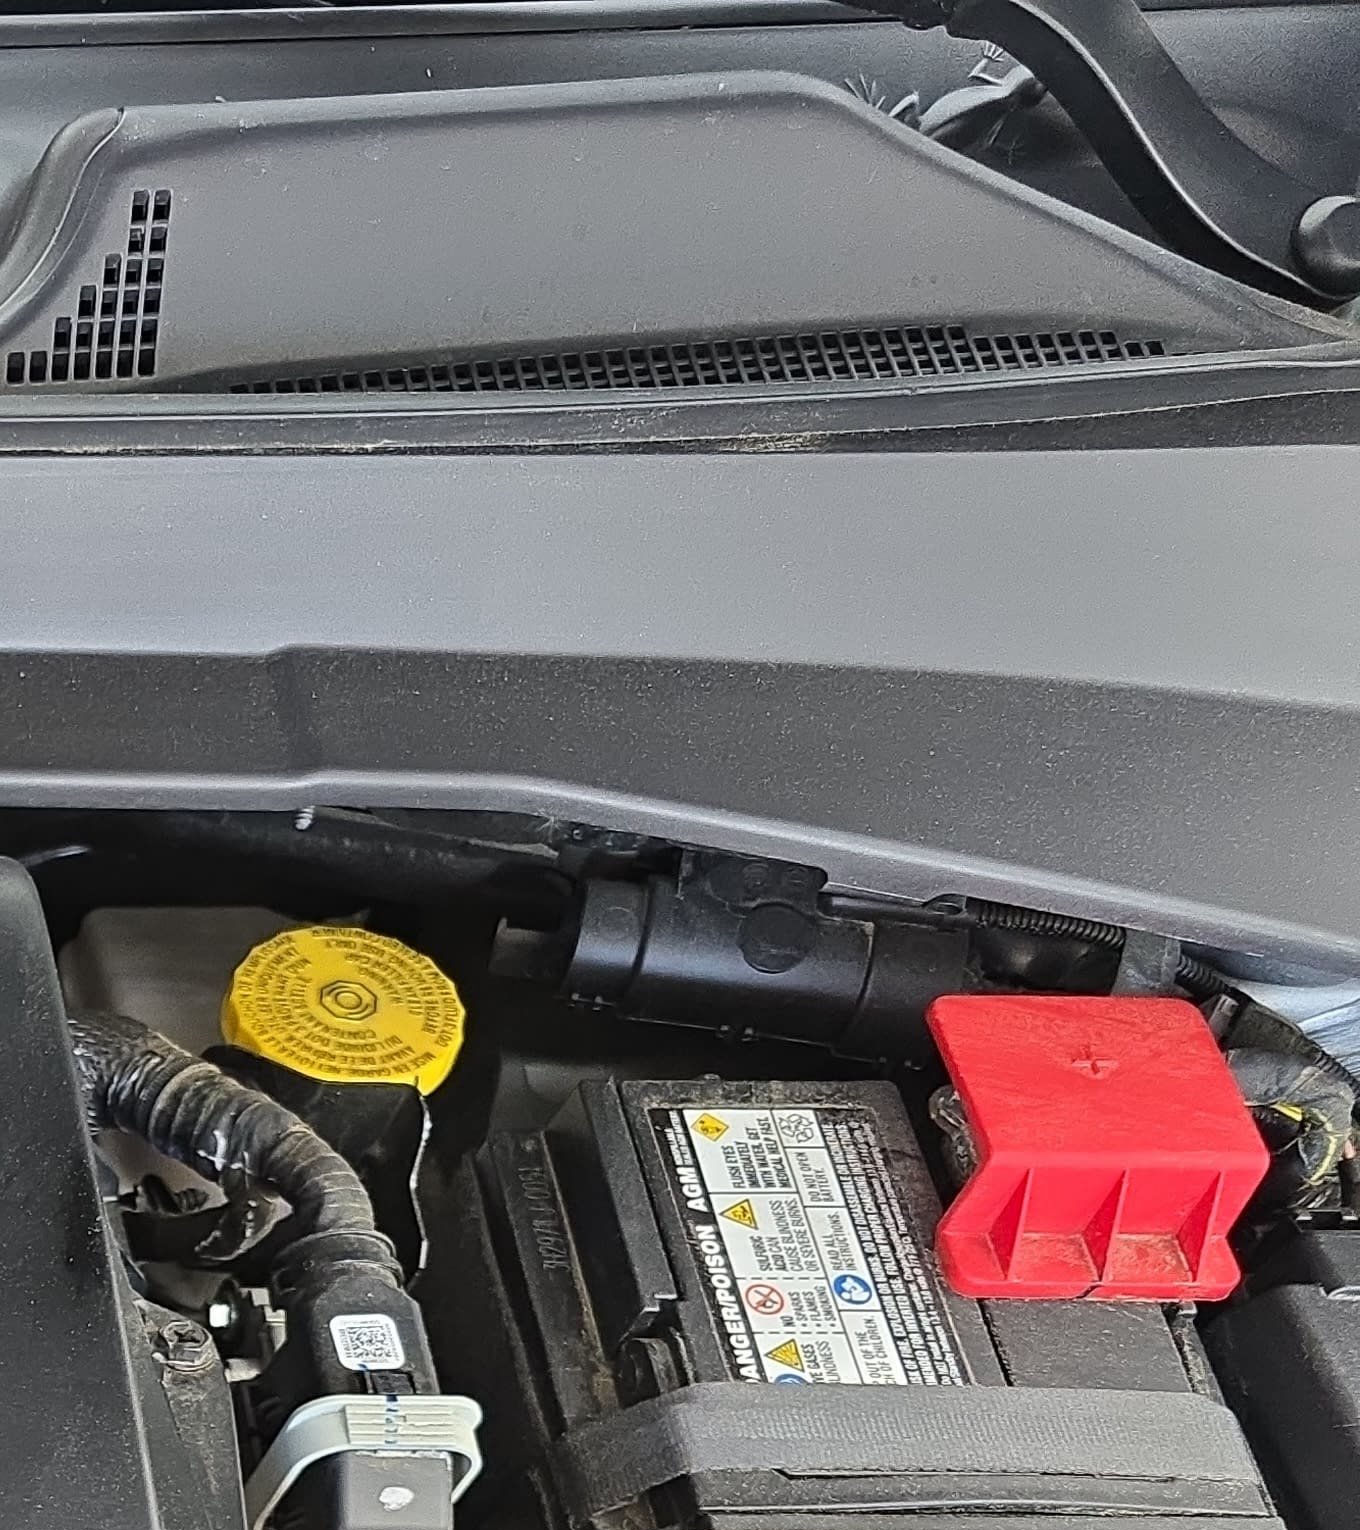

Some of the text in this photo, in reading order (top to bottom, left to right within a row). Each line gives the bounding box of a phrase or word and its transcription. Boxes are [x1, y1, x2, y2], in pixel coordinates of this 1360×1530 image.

[721, 1145, 746, 1187] FLUSH EYES
[794, 1152, 822, 1201] DO NOT OPEN
[674, 1166, 709, 1212] AGM
[768, 1199, 804, 1271] CAUSE BLINDNESS
[793, 1228, 814, 1257] SEVERE
[820, 1233, 844, 1270] READ ALL
[787, 1291, 807, 1321] SPARKS
[802, 1291, 822, 1321] FLAMES
[814, 1285, 835, 1321] SMOKING
